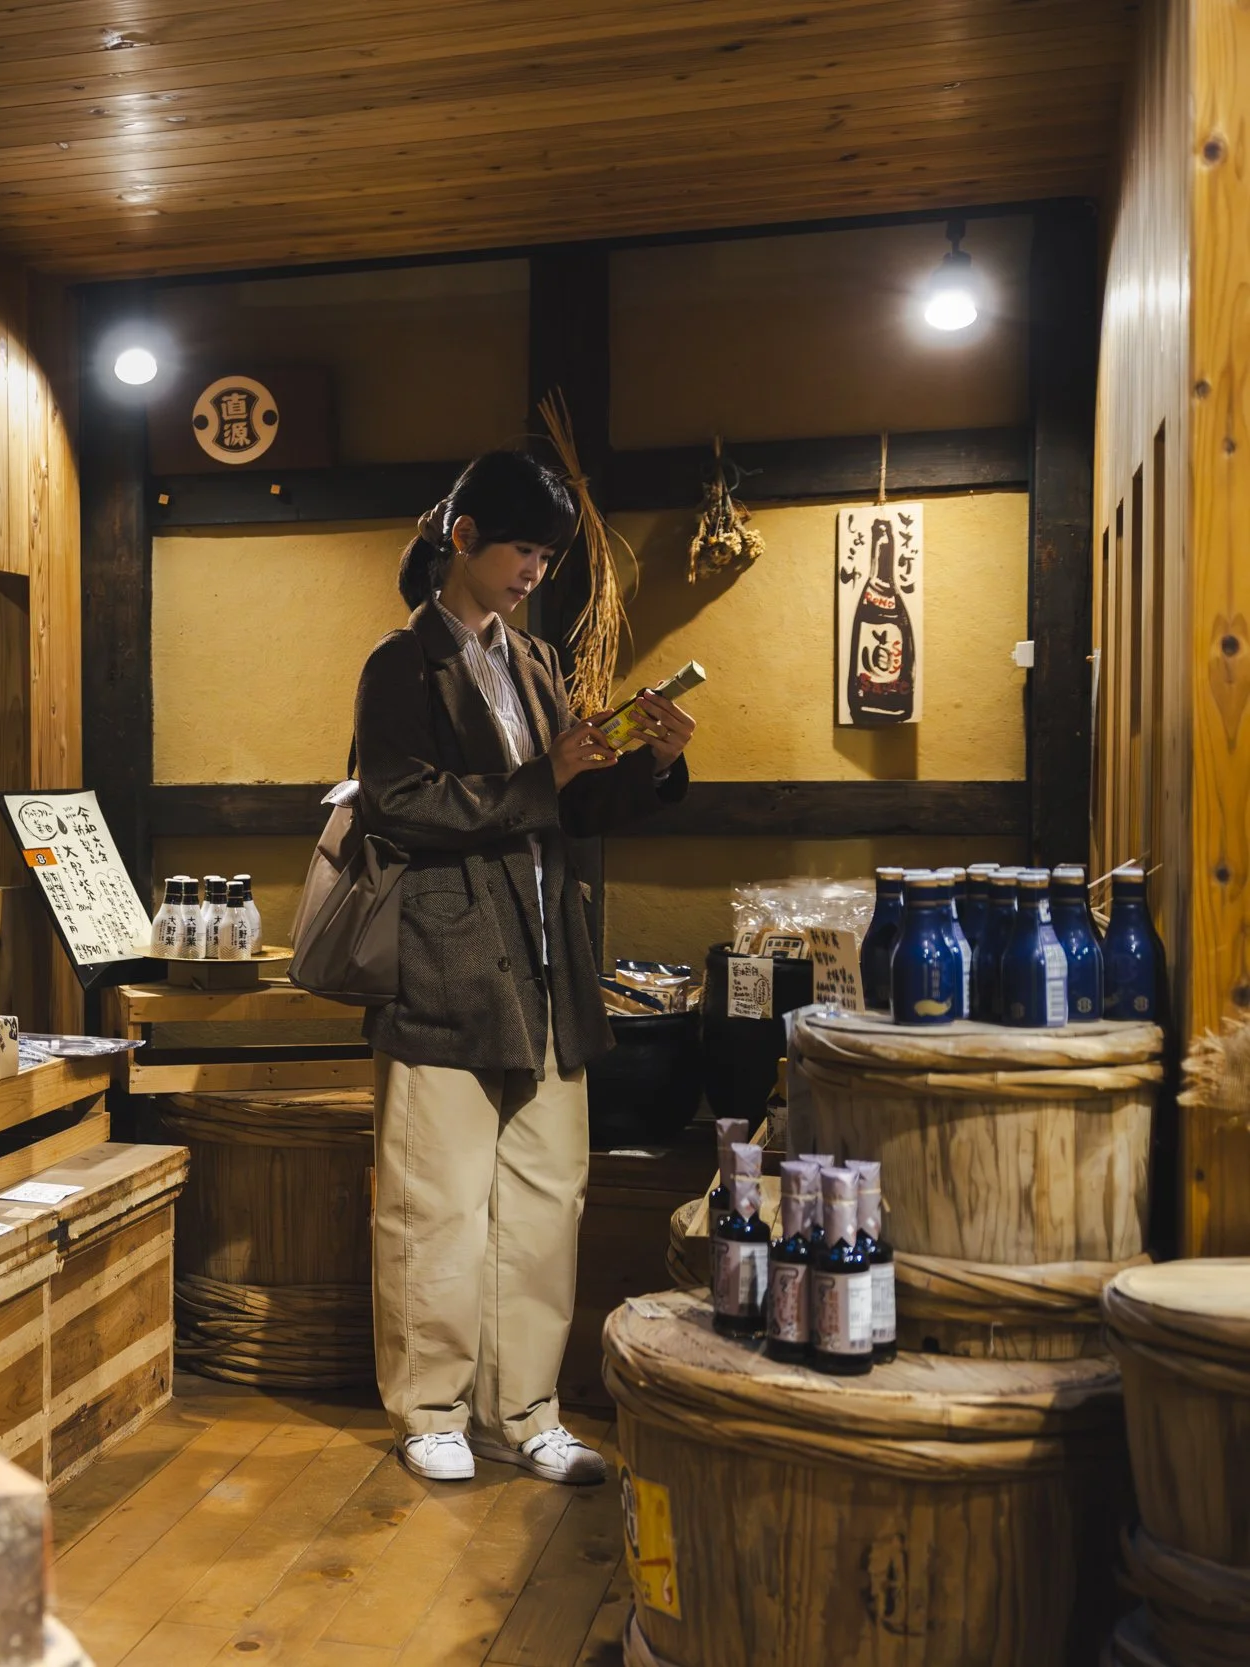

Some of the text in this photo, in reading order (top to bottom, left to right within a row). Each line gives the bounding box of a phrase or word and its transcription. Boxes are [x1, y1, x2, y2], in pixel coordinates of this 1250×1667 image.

[221, 392, 251, 447] 直源
[840, 514, 865, 593] しょうゆ
[77, 805, 108, 864] 令和六年
[62, 845, 96, 901] 大野紫
[165, 915, 176, 946] 大野紫
[186, 915, 197, 946] 大野紫
[238, 919, 248, 950] 大野紫
